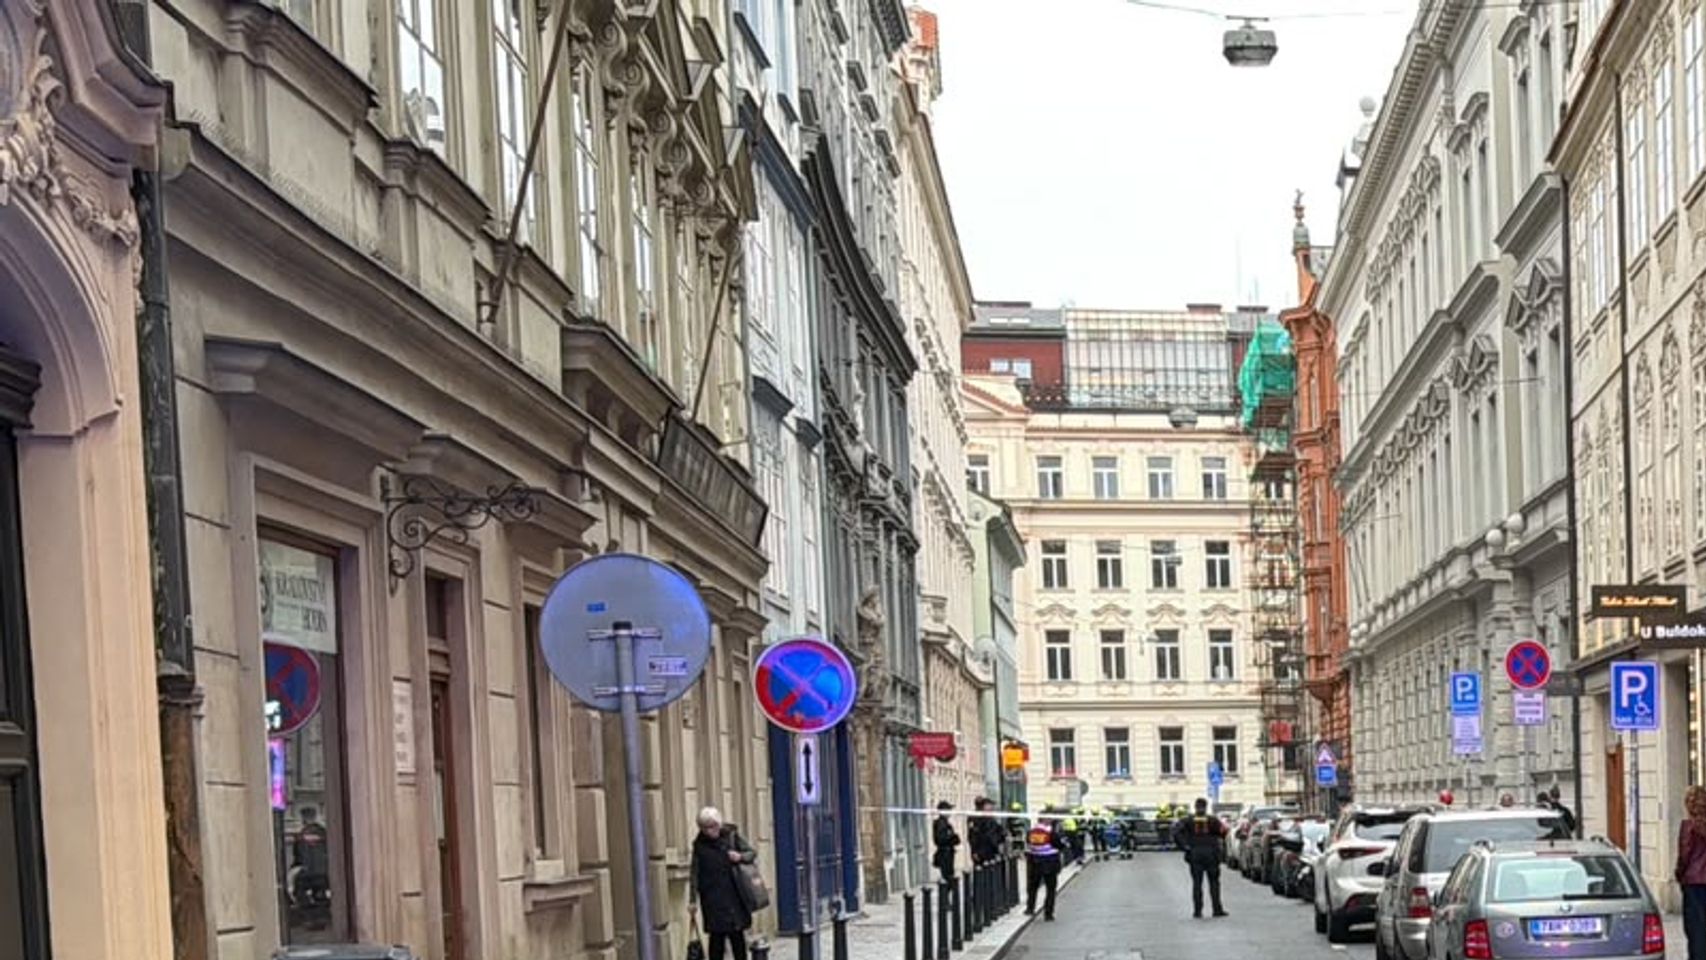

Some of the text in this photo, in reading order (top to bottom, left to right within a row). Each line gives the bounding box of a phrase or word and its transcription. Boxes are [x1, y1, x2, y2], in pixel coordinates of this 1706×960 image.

[1640, 626, 1652, 639] U
[1456, 677, 1474, 701] P
[1621, 670, 1648, 708] P
